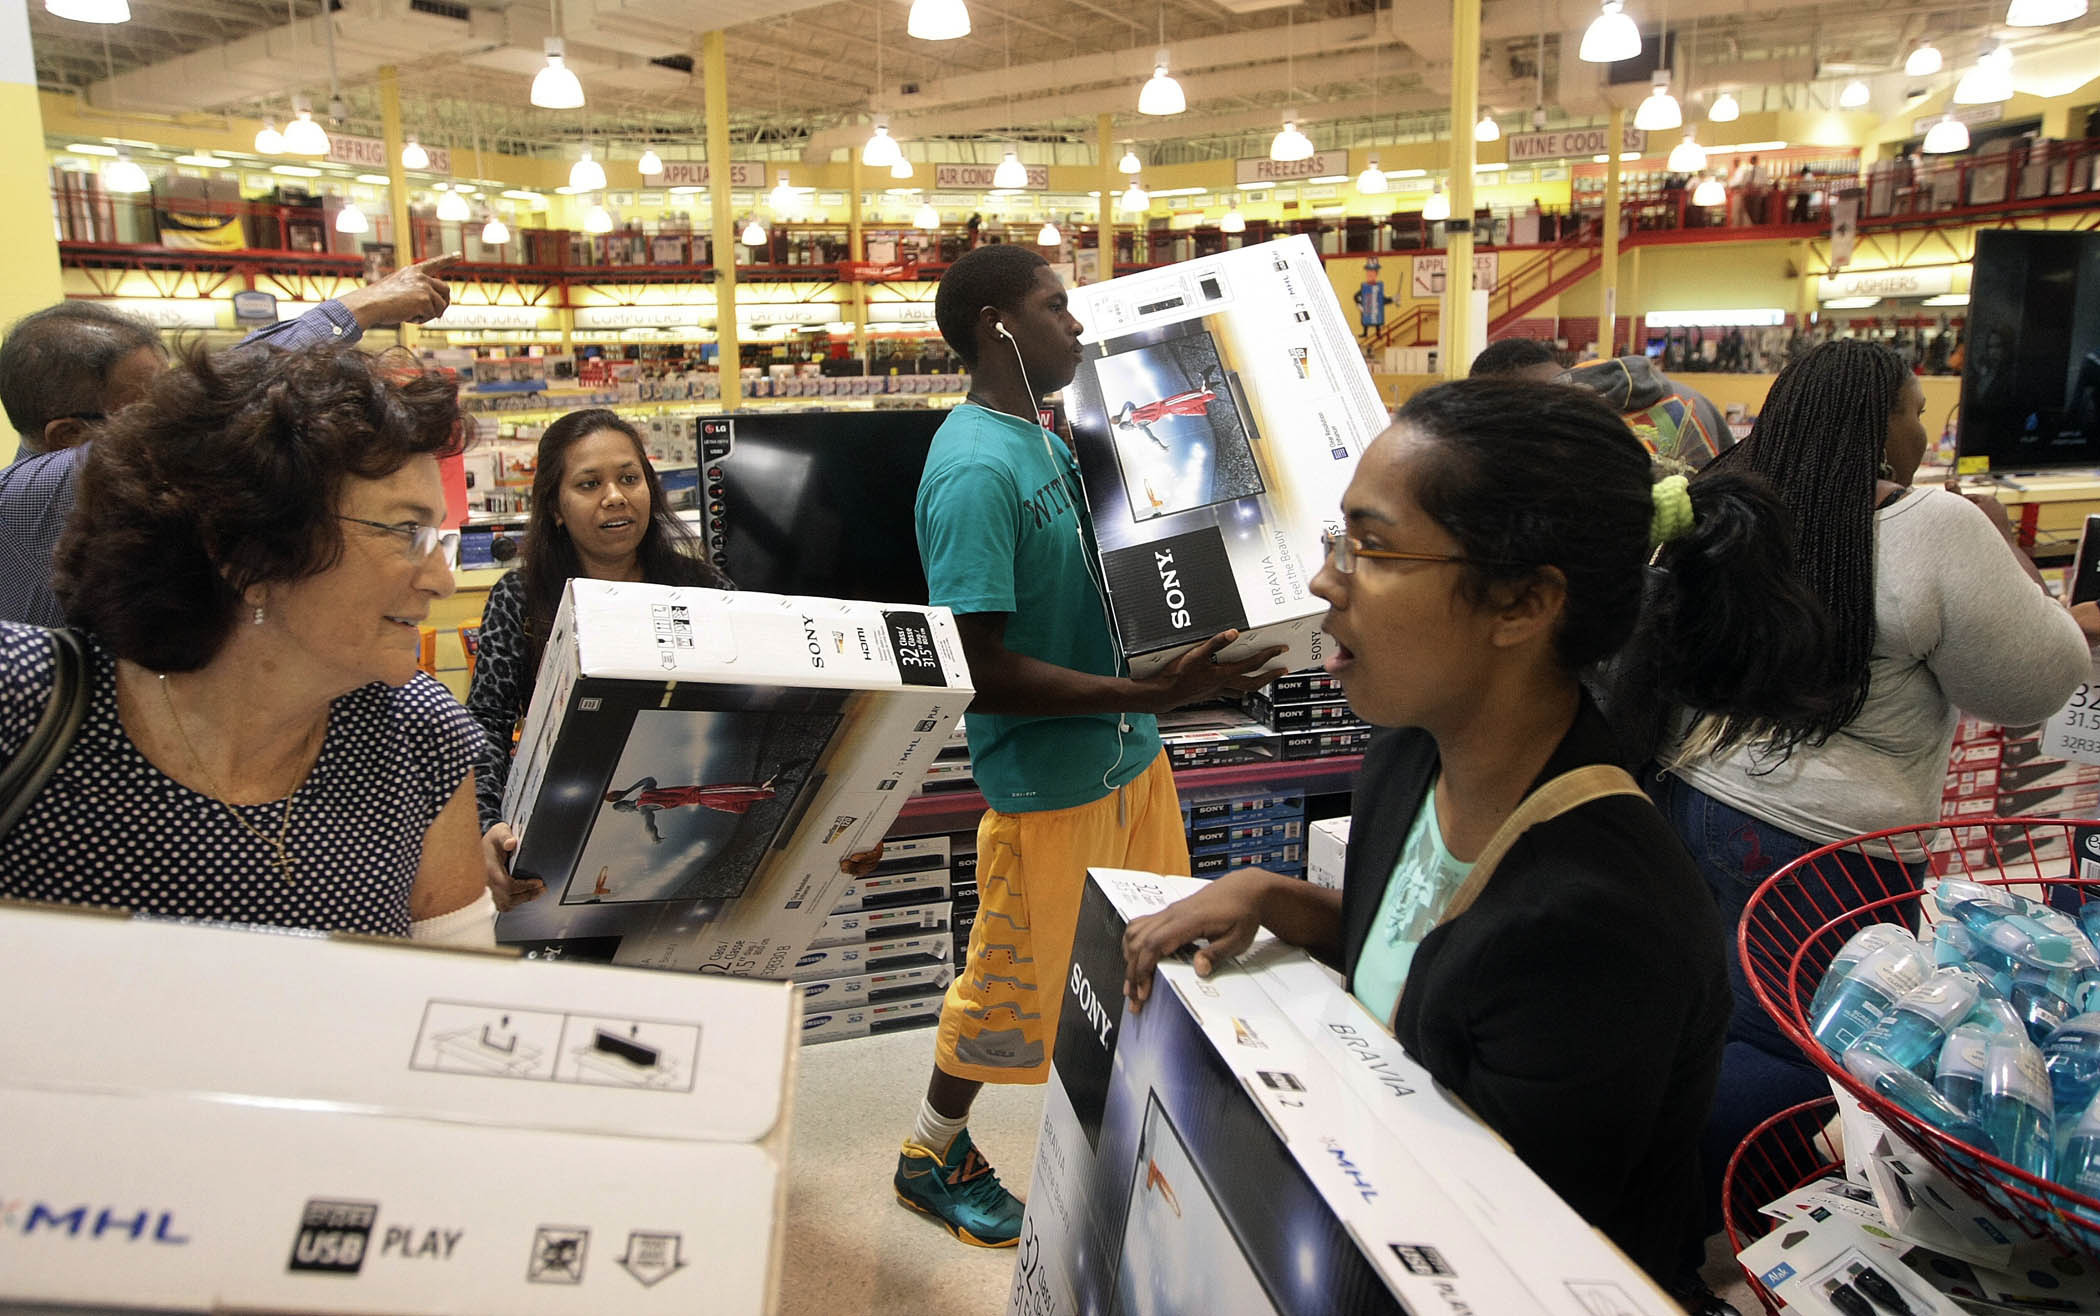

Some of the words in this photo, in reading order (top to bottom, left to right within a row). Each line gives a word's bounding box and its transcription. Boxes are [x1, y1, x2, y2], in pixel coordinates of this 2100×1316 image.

[1513, 135, 1556, 155] WINE
[1563, 130, 1640, 152] COOLRS
[664, 166, 746, 183] APPLIAES
[938, 168, 958, 185] AIR
[1257, 157, 1324, 178] FREEZERS
[715, 425, 727, 433] LG
[1262, 556, 1285, 605] BRAVIA
[802, 615, 825, 669] SONY
[1312, 631, 1321, 660] SONY
[900, 648, 922, 667] 32
[1278, 682, 1302, 690] SONY
[1279, 710, 1304, 718] SONY
[900, 737, 921, 760] MHL
[1288, 738, 1313, 746] SONY
[1199, 805, 1224, 813] SONY
[1199, 832, 1224, 840] SONY
[958, 859, 977, 867] SON
[1198, 860, 1223, 868] SONY
[958, 889, 978, 897] SON
[1328, 1024, 1416, 1097] BRAVIA
[1044, 1114, 1065, 1176] BRAVIA
[1327, 1148, 1379, 1205] MHL
[20, 1201, 190, 1245] MHL
[296, 1229, 370, 1265] USB
[381, 1226, 464, 1260] PLAY
[1021, 1215, 1040, 1296] 32
